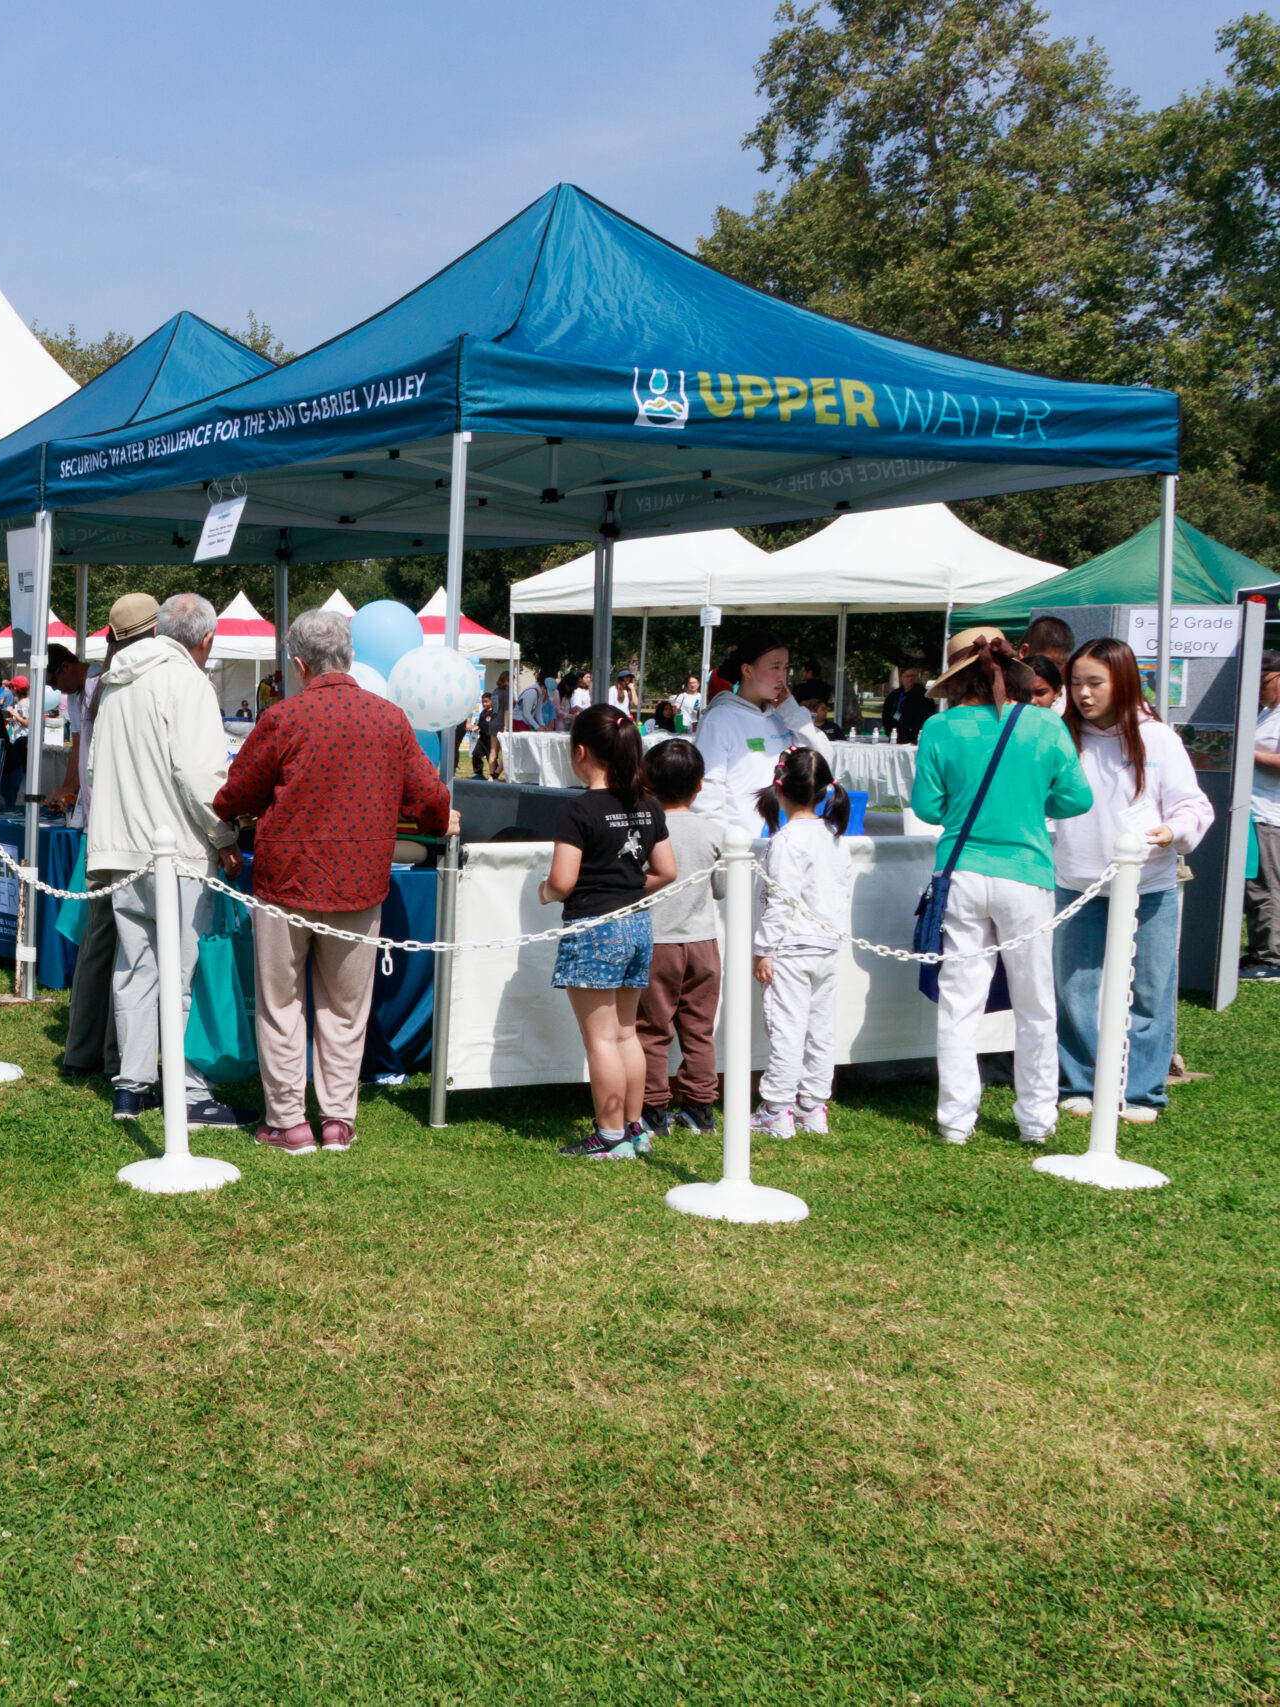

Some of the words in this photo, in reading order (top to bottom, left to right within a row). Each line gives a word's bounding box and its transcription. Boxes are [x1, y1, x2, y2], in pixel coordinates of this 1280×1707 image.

[59, 449, 108, 479] SECURING
[108, 441, 145, 466] WATER
[147, 427, 213, 459] RESILIENCE
[213, 418, 240, 443] FOR
[243, 413, 265, 437] THE
[268, 404, 296, 431] SAN
[298, 389, 360, 425] GABRIEL
[362, 371, 427, 409] VALLEY
[697, 370, 880, 428] UPPER
[881, 384, 1051, 441] WATER
[1135, 617, 1144, 629] 9
[1184, 616, 1233, 629] Grade
[1146, 638, 1219, 654] Ctegory
